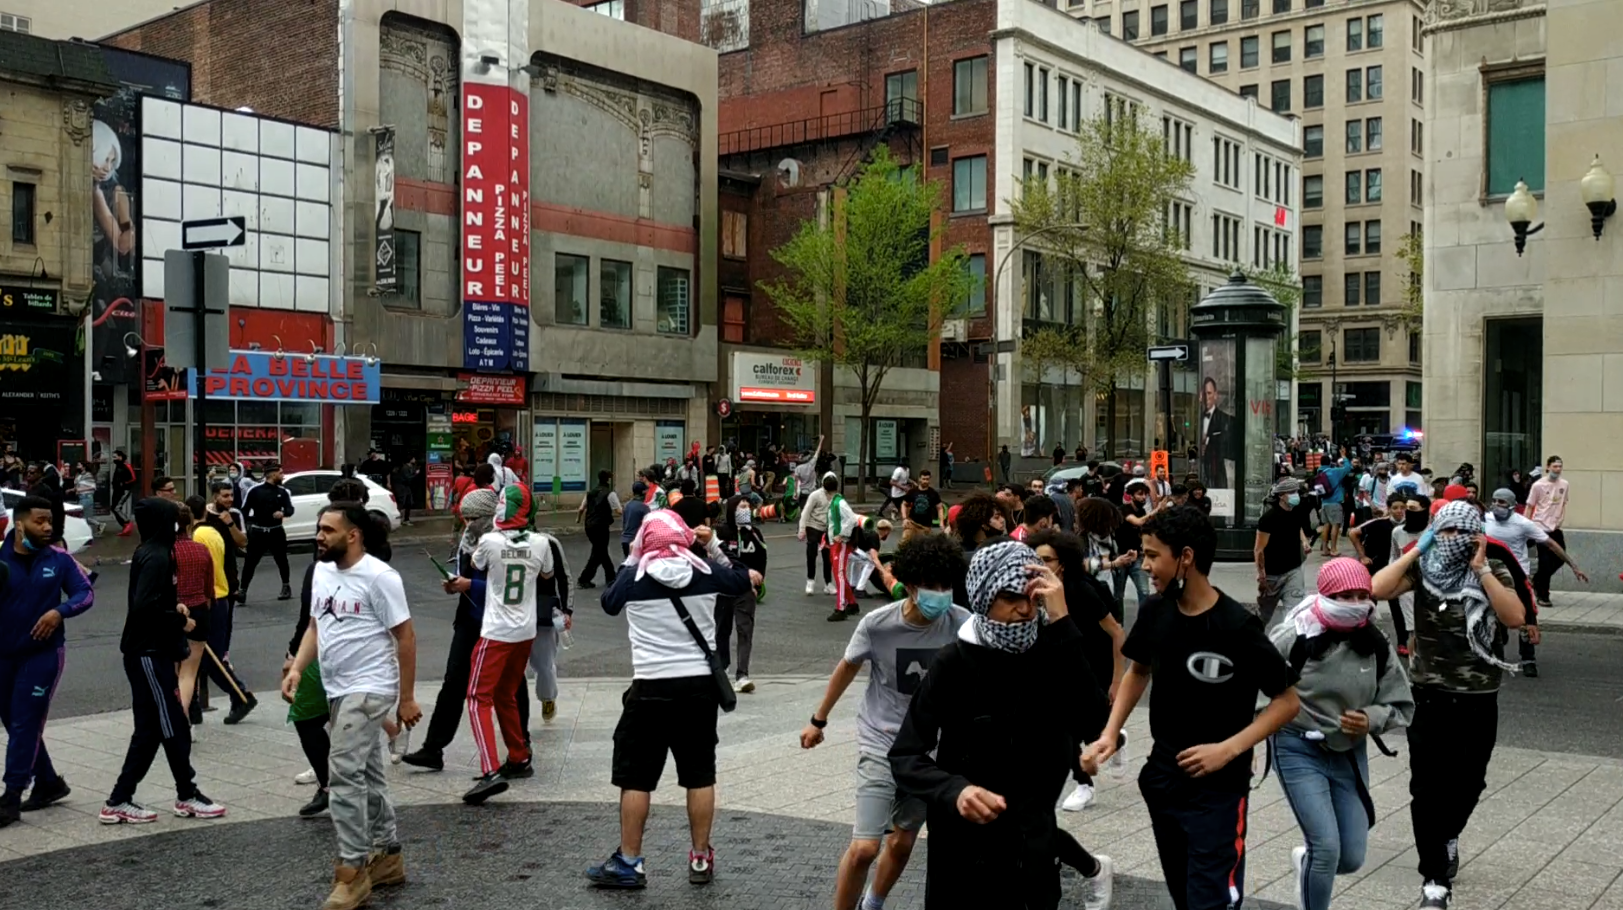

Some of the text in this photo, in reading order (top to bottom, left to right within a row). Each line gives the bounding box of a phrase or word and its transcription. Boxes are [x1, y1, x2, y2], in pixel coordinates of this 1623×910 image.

[466, 95, 483, 296] DEPANNEUR
[511, 100, 520, 298] DEPANNEUR
[494, 184, 505, 240] PIZZA
[495, 252, 505, 297] PEEL
[22, 292, 43, 300] Tables
[467, 313, 481, 322] Pizza
[473, 325, 499, 333] Souvenirs
[475, 336, 497, 345] Cadeaux
[468, 347, 480, 355] Loto
[268, 356, 364, 380] BELLE
[753, 362, 794, 376] calforex
[205, 376, 368, 400] PROVINCE
[470, 376, 516, 387] DEPANNEUR
[472, 384, 494, 392] PIZZA
[2, 391, 34, 399] ALEXANDER
[729, 540, 756, 553] FLA
[504, 564, 526, 605] 8
